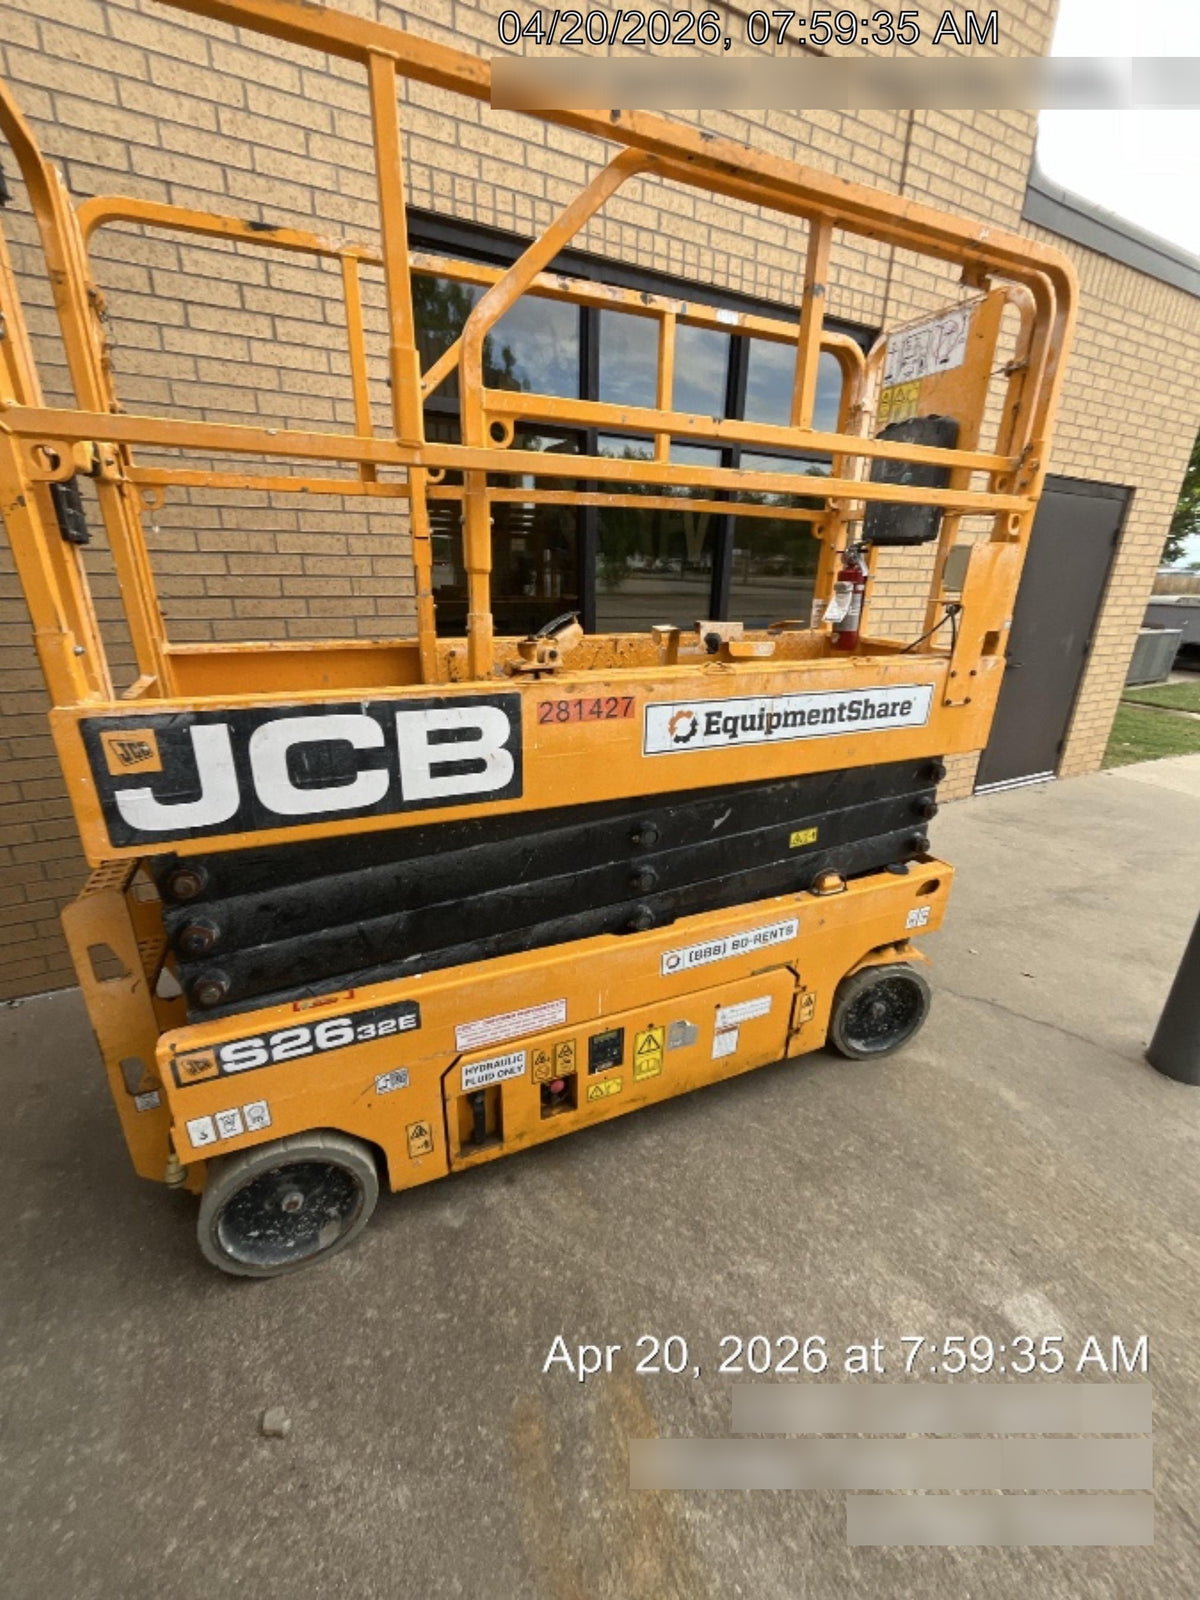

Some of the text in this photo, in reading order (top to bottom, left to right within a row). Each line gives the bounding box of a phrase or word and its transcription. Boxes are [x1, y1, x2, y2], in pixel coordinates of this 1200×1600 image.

[539, 696, 634, 725] 281427
[703, 697, 913, 738] EquipmentShare
[114, 704, 515, 832] JCB
[465, 1054, 524, 1076] HYDRAULIC
[465, 1064, 524, 1087] FLUID ONLY
